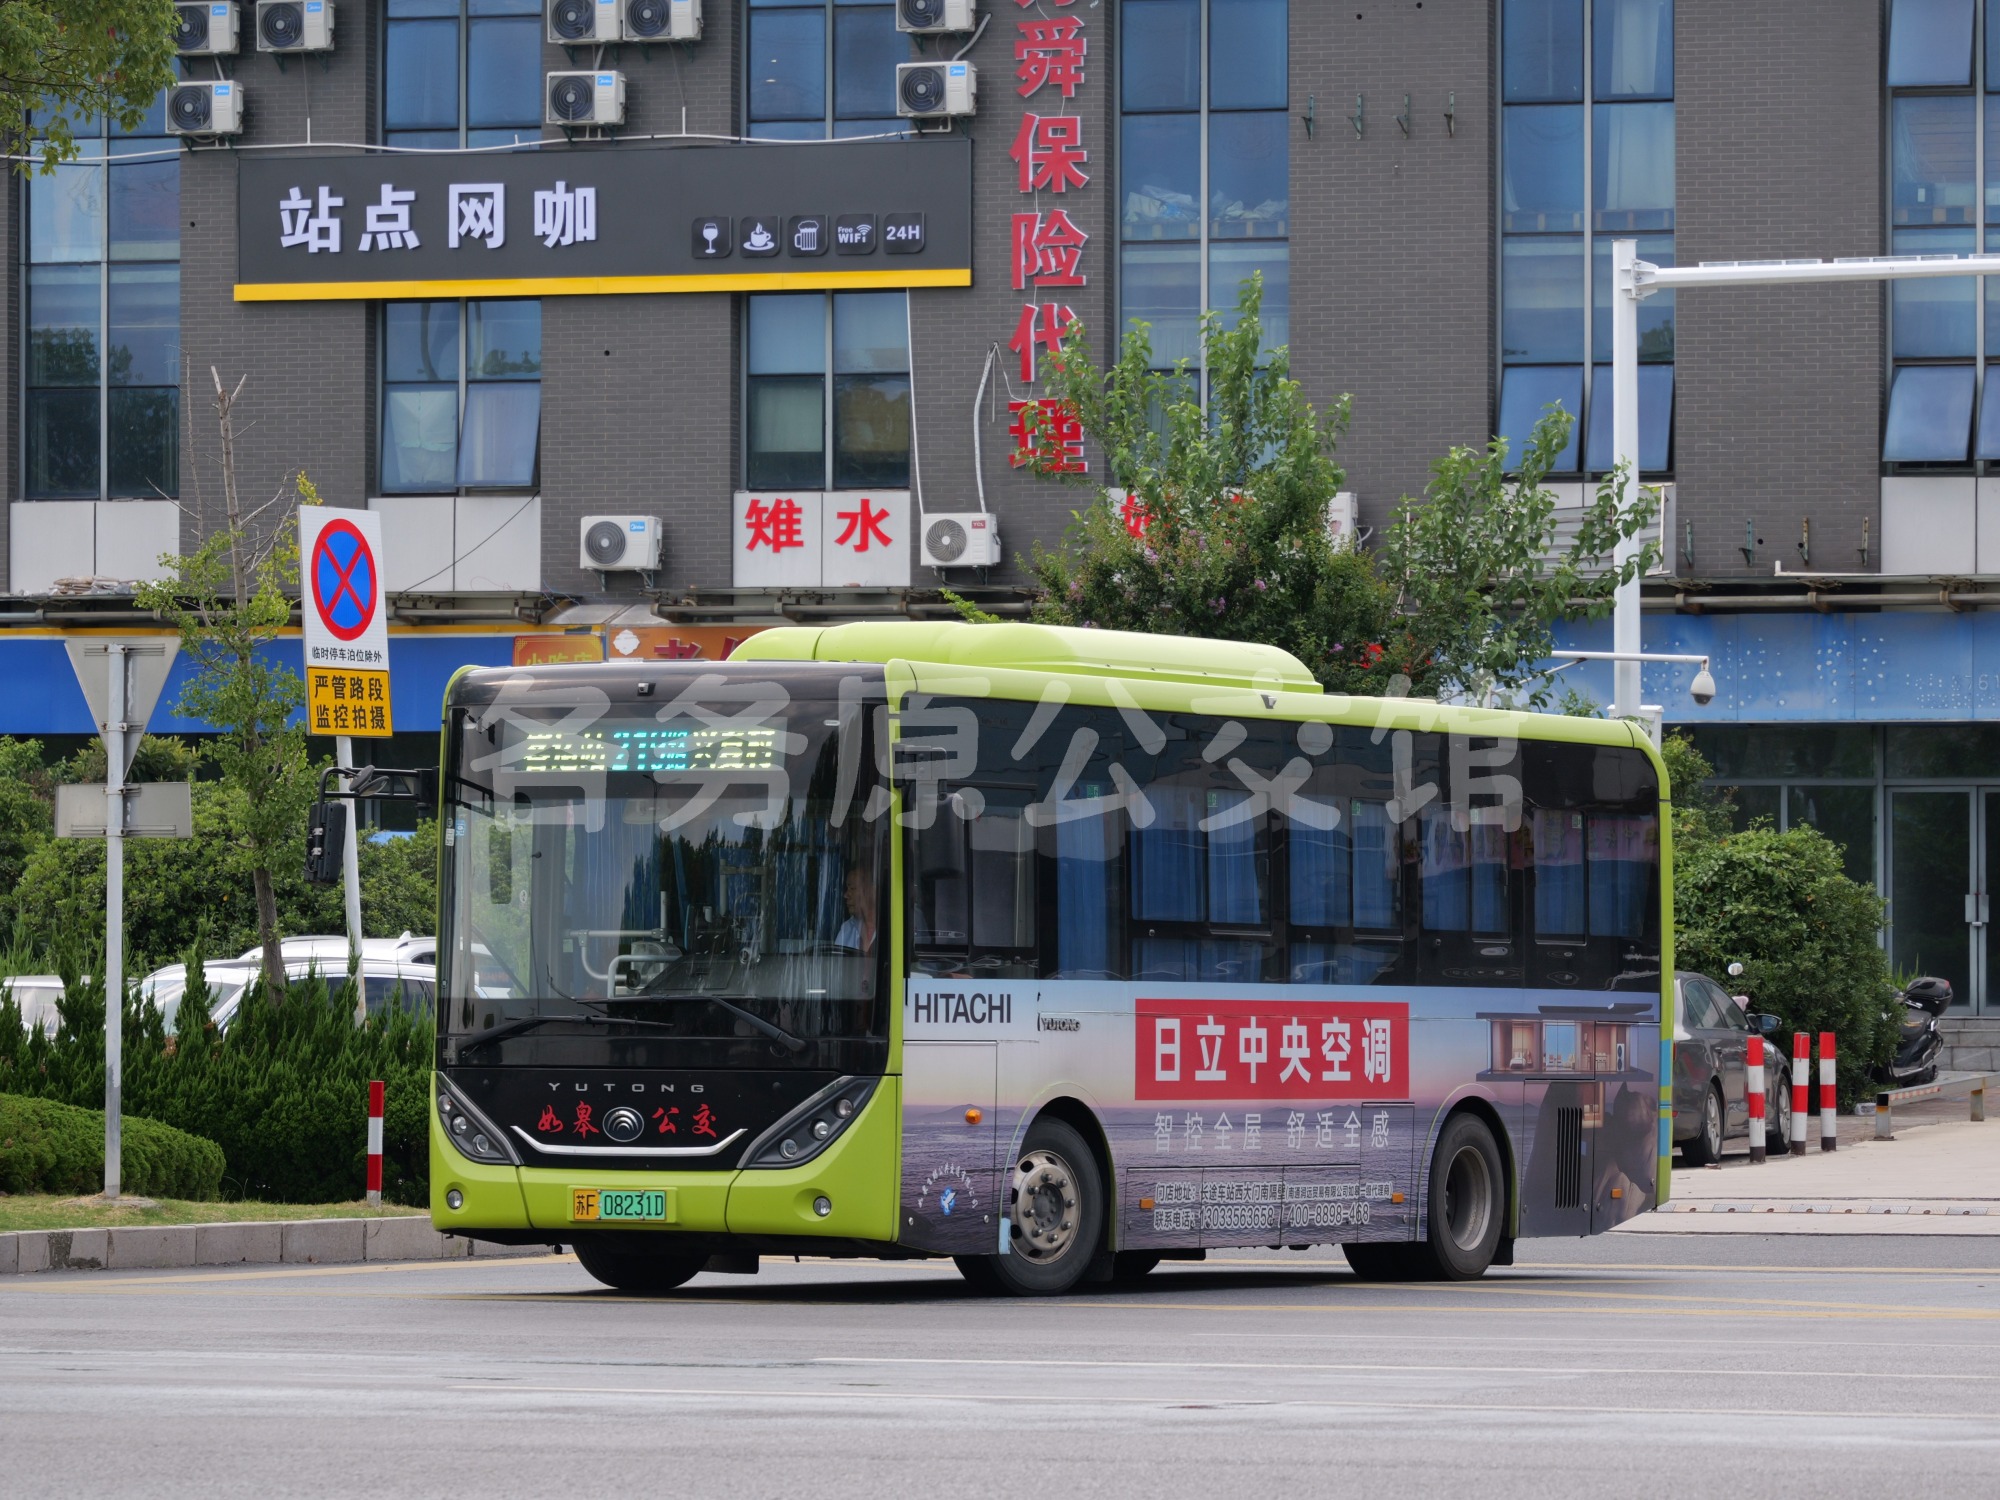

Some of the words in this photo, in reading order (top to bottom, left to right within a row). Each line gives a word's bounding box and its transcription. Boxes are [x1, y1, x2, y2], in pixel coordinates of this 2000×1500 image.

[279, 181, 597, 253] 站点网咖
[886, 225, 920, 240] 24H
[1009, 0, 1089, 473] 舜保险代理
[745, 498, 893, 553] 雉水
[312, 646, 382, 663] 临时停车泊位除外
[314, 674, 384, 701] 严管路段
[316, 703, 386, 730] 监控拍摄
[914, 993, 1011, 1023] HITACHI
[1041, 1018, 1081, 1031] YUTONG
[1155, 1015, 1391, 1083] 日立中央空调
[548, 1082, 705, 1093] YUTONG
[1154, 1111, 1262, 1152] 智控全屋
[1286, 1110, 1390, 1148] 舒适全感
